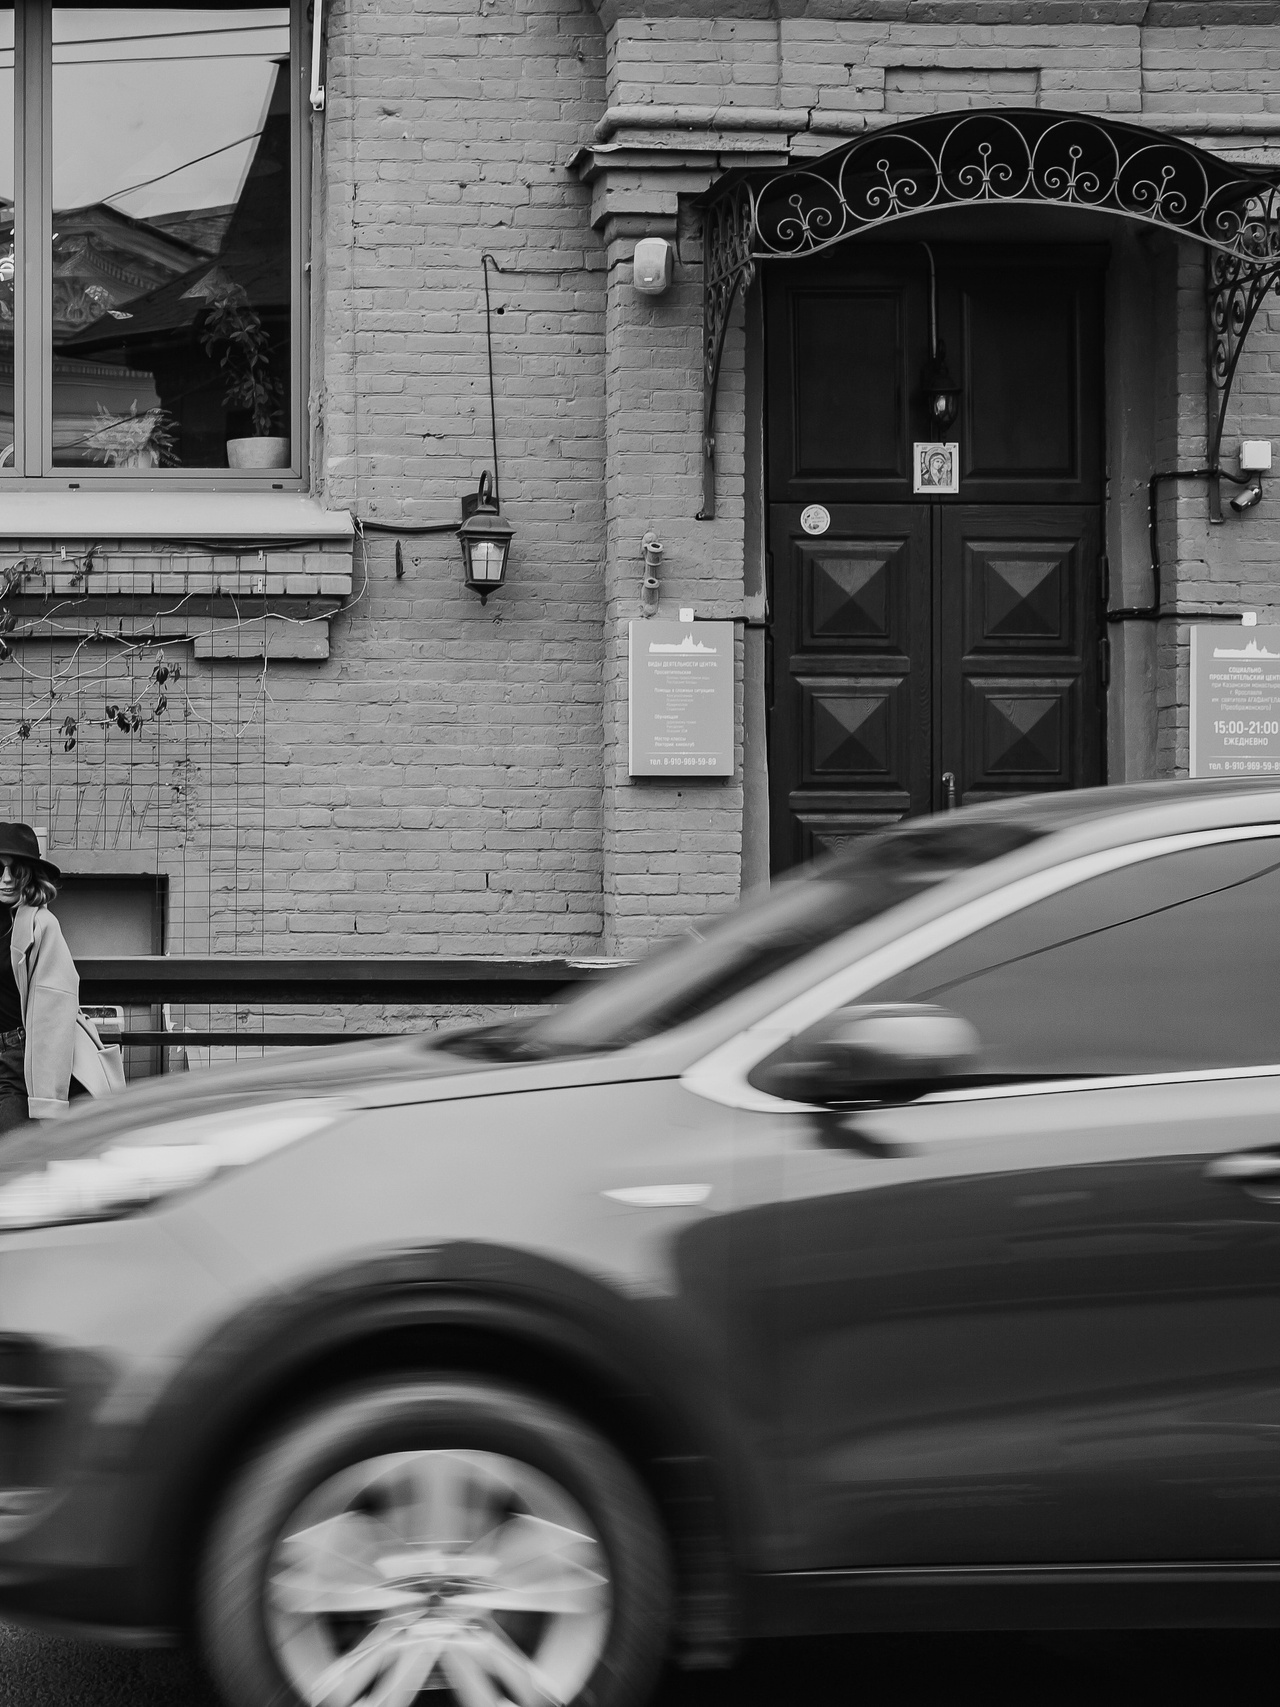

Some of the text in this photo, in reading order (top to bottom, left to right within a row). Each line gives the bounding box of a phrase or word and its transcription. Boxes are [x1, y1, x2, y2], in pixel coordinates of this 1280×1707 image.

[1213, 720, 1279, 734] 15:00-21:00
[1223, 737, 1269, 746] ЕЖЕДНЕВНО
[663, 757, 717, 766] 8-910-969-59-89
[1208, 762, 1223, 770] тел.
